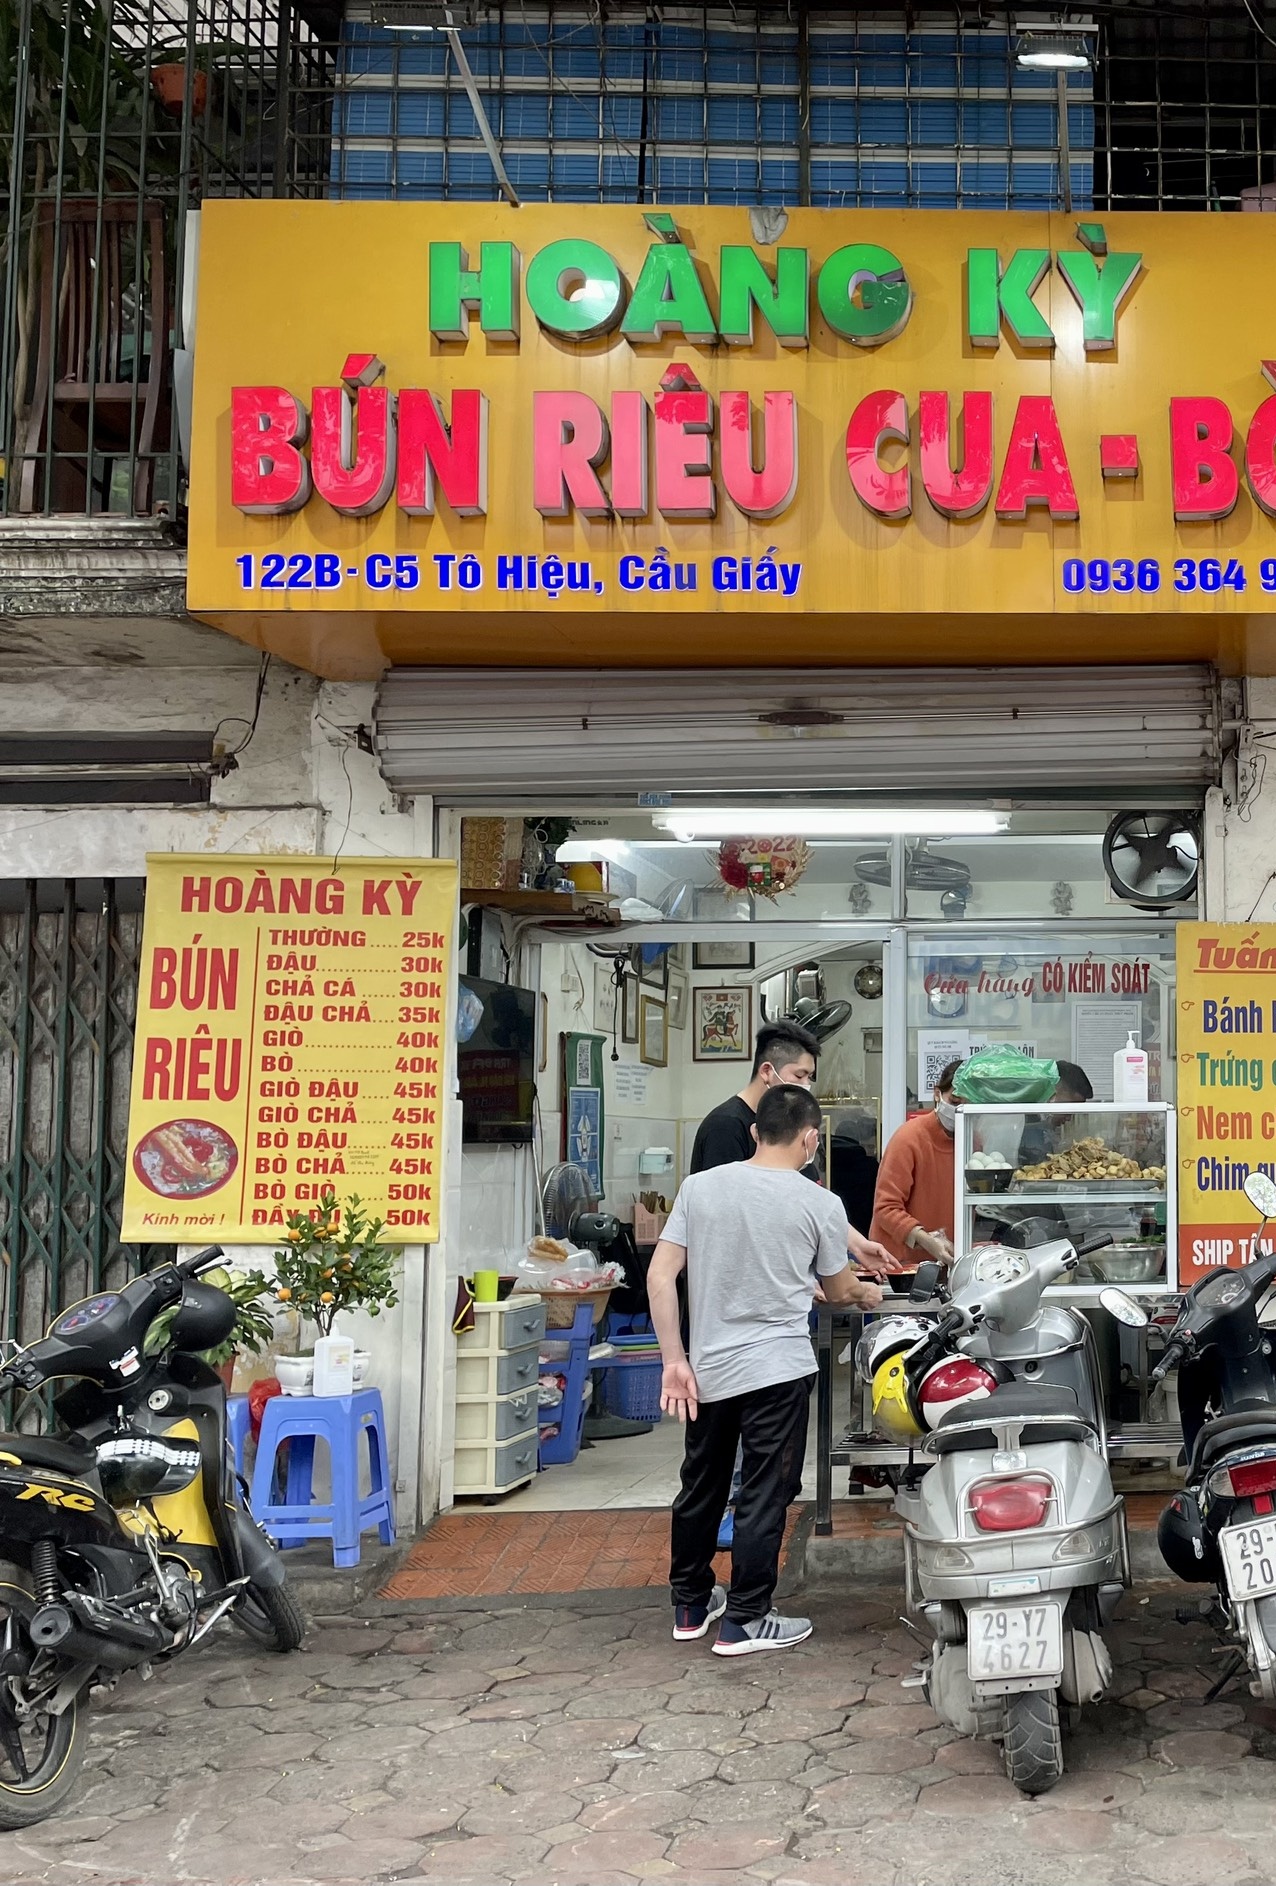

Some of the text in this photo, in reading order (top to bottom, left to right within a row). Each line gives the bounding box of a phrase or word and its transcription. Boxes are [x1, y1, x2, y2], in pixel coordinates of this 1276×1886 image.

[429, 213, 1143, 350] HOÀNG KỲ
[231, 353, 488, 516] BÚN
[533, 363, 799, 519] RIÊU
[846, 390, 1080, 520] CUA
[433, 553, 481, 591] Tô
[497, 554, 604, 599] Hiệu,
[619, 546, 698, 592] Cầu
[713, 545, 803, 597] Giấy
[1062, 558, 1161, 593] 0936
[1173, 558, 1247, 593] 364
[181, 870, 423, 916] HOÀNG KỲ
[269, 926, 445, 949] THƯỜNG 25k
[149, 934, 240, 1011] BÚN
[267, 952, 443, 974] ĐẬU 30k
[977, 970, 1034, 997] hàng
[1042, 957, 1063, 993] CÓ
[1067, 951, 1106, 993] KIỂM
[1111, 957, 1150, 994] SOÁT
[265, 975, 441, 998] CHẢ CÁ 30k
[264, 1001, 440, 1025] ĐẬU CHẢ 35k
[1203, 996, 1262, 1033] Bánh
[262, 1026, 439, 1048] GIÒ 40k
[142, 1023, 243, 1102] RIÊU
[261, 1052, 438, 1074] BÒ 40k
[1197, 1050, 1263, 1091] Trứng
[260, 1077, 437, 1103] GIÒ ĐẬU 45k
[258, 1102, 435, 1124] GIÒ CHẢ 45k
[1197, 1106, 1252, 1139] Nem
[256, 1128, 434, 1152] BÒ ĐẬU 45k
[255, 1153, 287, 1174] BÒ
[296, 1152, 346, 1175] CHẢ
[389, 1158, 432, 1175] 45k
[1197, 1156, 1249, 1191] Chim
[254, 1178, 432, 1201] BÒ GIÒ 50k
[184, 1213, 215, 1225] mời
[386, 1209, 430, 1226] 50k
[1192, 1239, 1233, 1266] SHIP
[982, 1608, 1047, 1641] 29-Y7
[982, 1641, 1048, 1673] 4627
